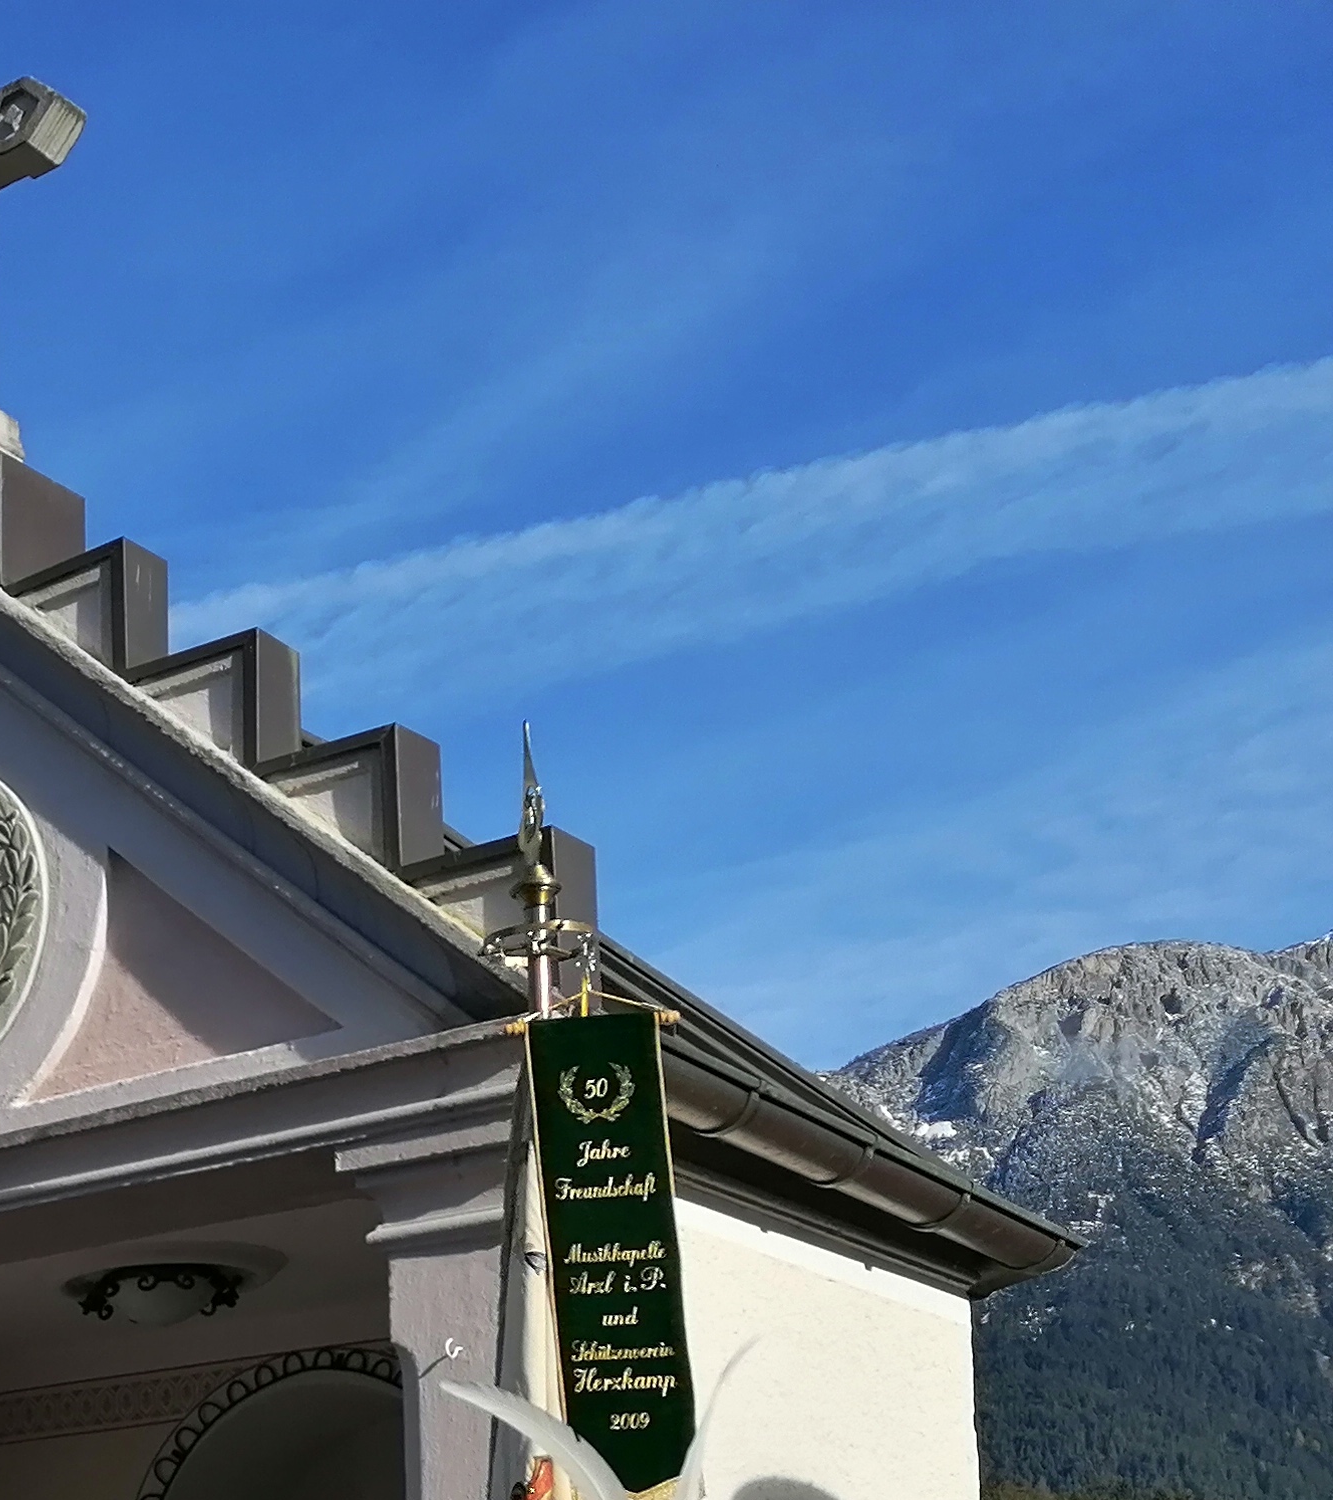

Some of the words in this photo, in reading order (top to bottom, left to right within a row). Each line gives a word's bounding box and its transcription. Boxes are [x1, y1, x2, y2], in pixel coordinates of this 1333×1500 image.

[583, 1078, 608, 1099] 50
[576, 1139, 631, 1167] Jahre
[555, 1172, 657, 1202] Freundschaft
[564, 1240, 667, 1268] Musikkapelle
[569, 1271, 616, 1295] Arzl
[602, 1306, 639, 1326] und
[571, 1340, 676, 1362] Schützenverein
[573, 1366, 677, 1397] Herzkamp
[610, 1412, 651, 1430] 2009
